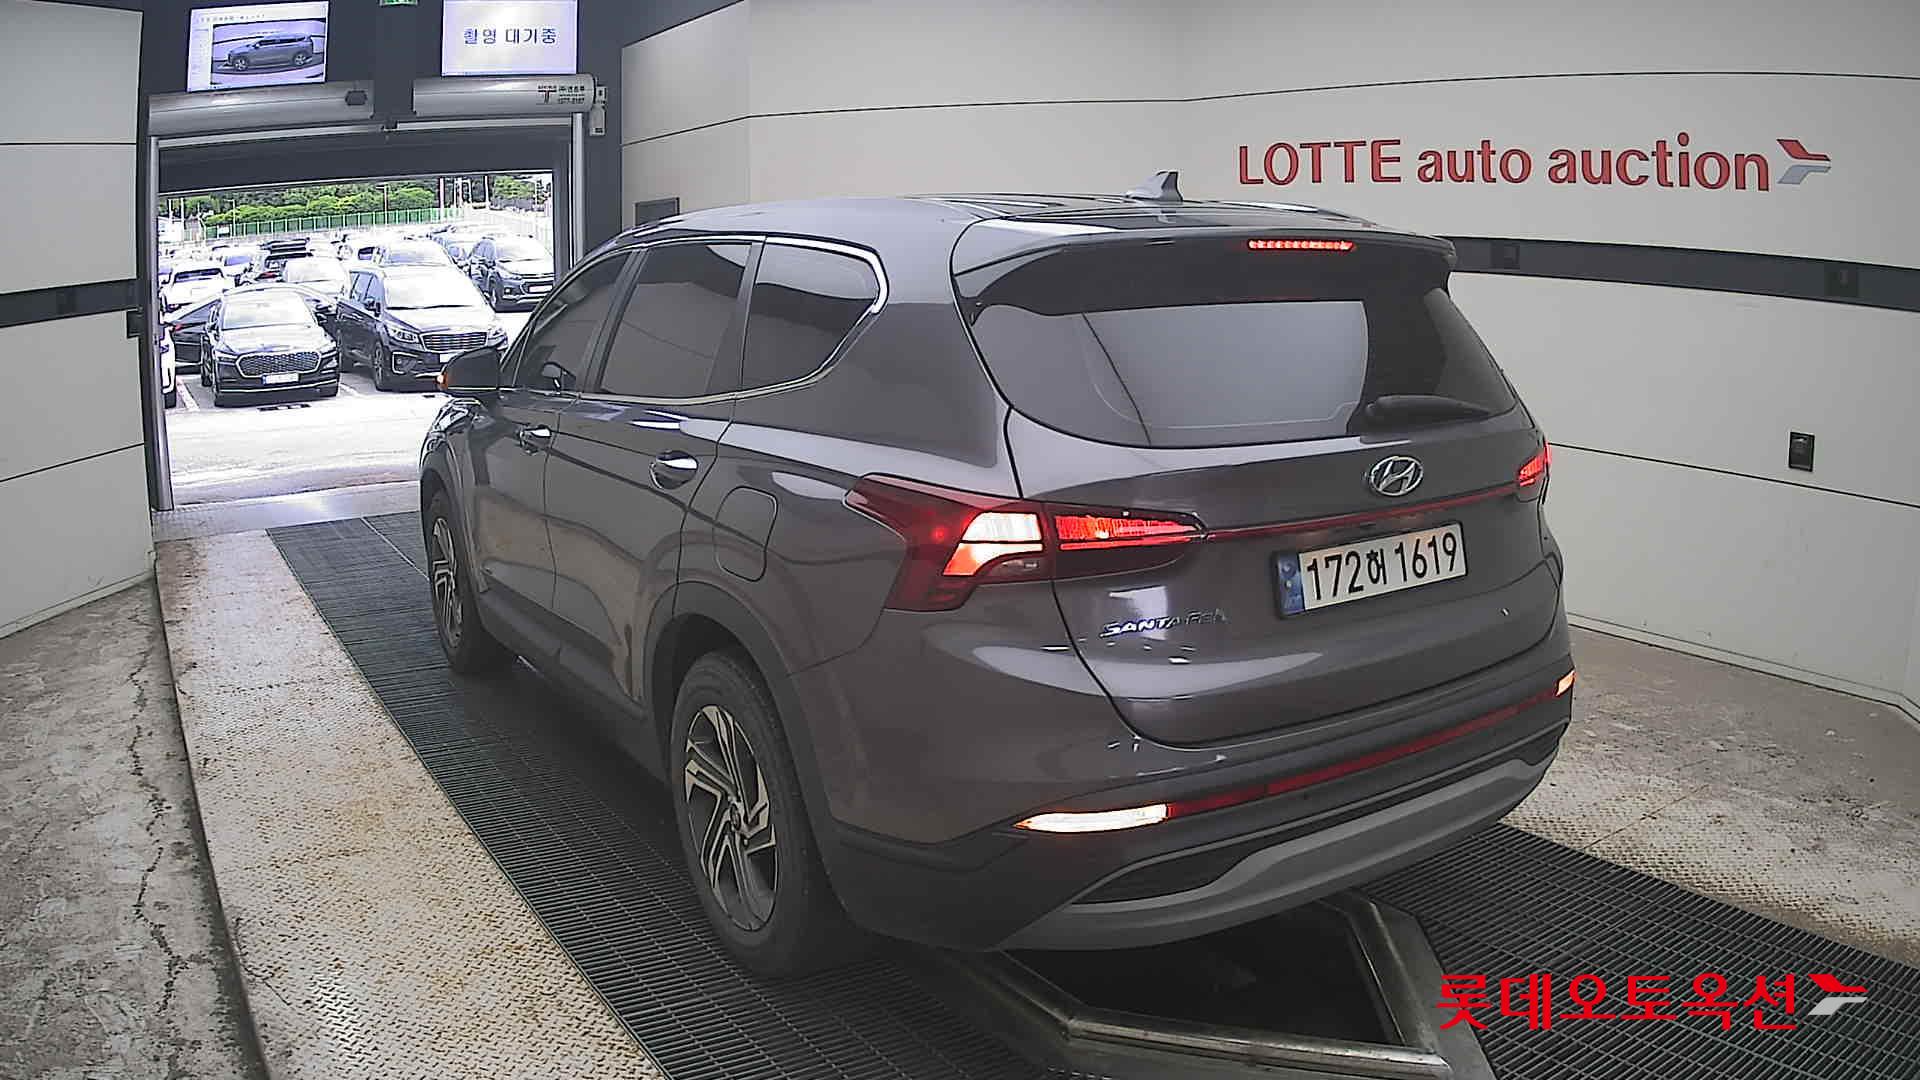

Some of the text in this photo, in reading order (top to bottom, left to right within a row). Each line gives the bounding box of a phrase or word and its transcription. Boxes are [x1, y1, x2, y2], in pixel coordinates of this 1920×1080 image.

[505, 27, 557, 45] 대기중
[1239, 132, 1769, 191] LOTTE auto auction
[1307, 532, 1457, 600] 172허 1619
[1100, 616, 1181, 638] SANTA
